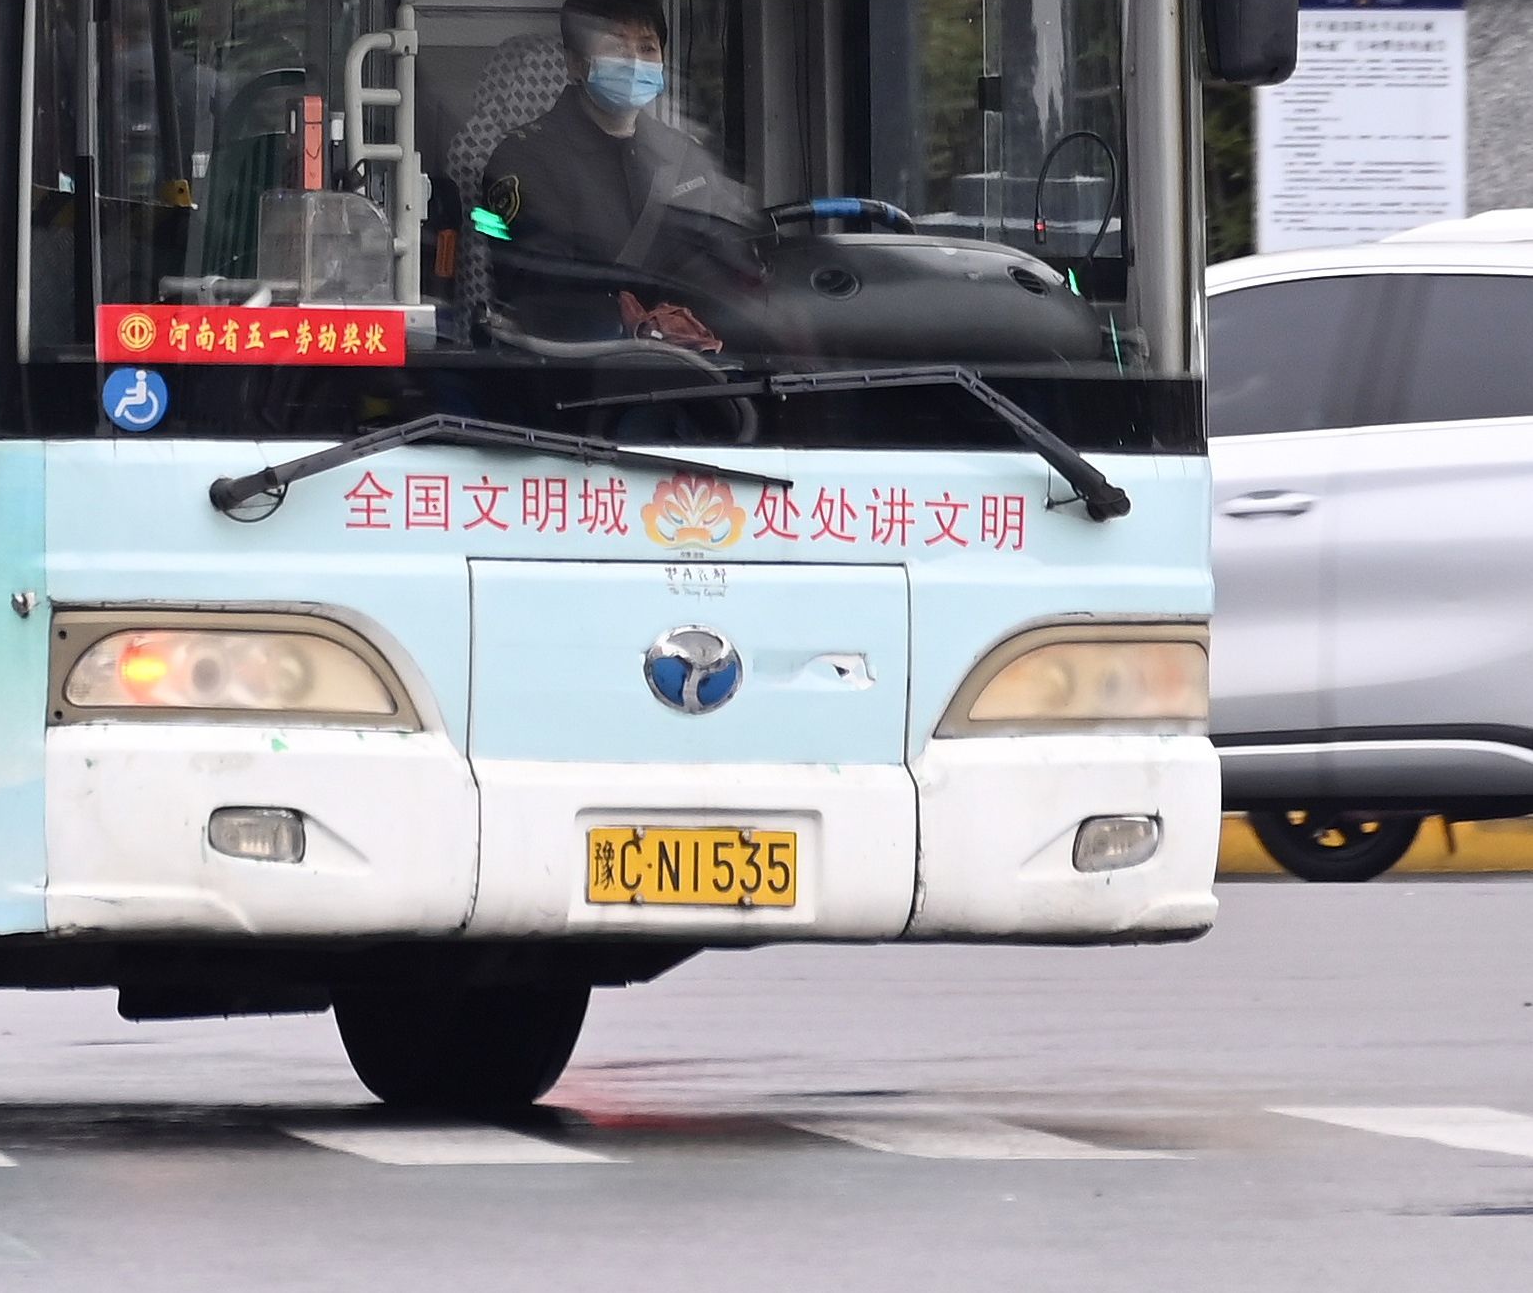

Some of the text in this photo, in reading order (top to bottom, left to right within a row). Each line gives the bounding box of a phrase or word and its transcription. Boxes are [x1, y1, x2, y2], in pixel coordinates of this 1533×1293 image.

[168, 319, 387, 355] 河南省五一劳动奖状
[343, 470, 629, 537] 全国文明城
[752, 483, 1027, 552] 处处讲文明
[594, 841, 791, 894] 豫C·N1535
